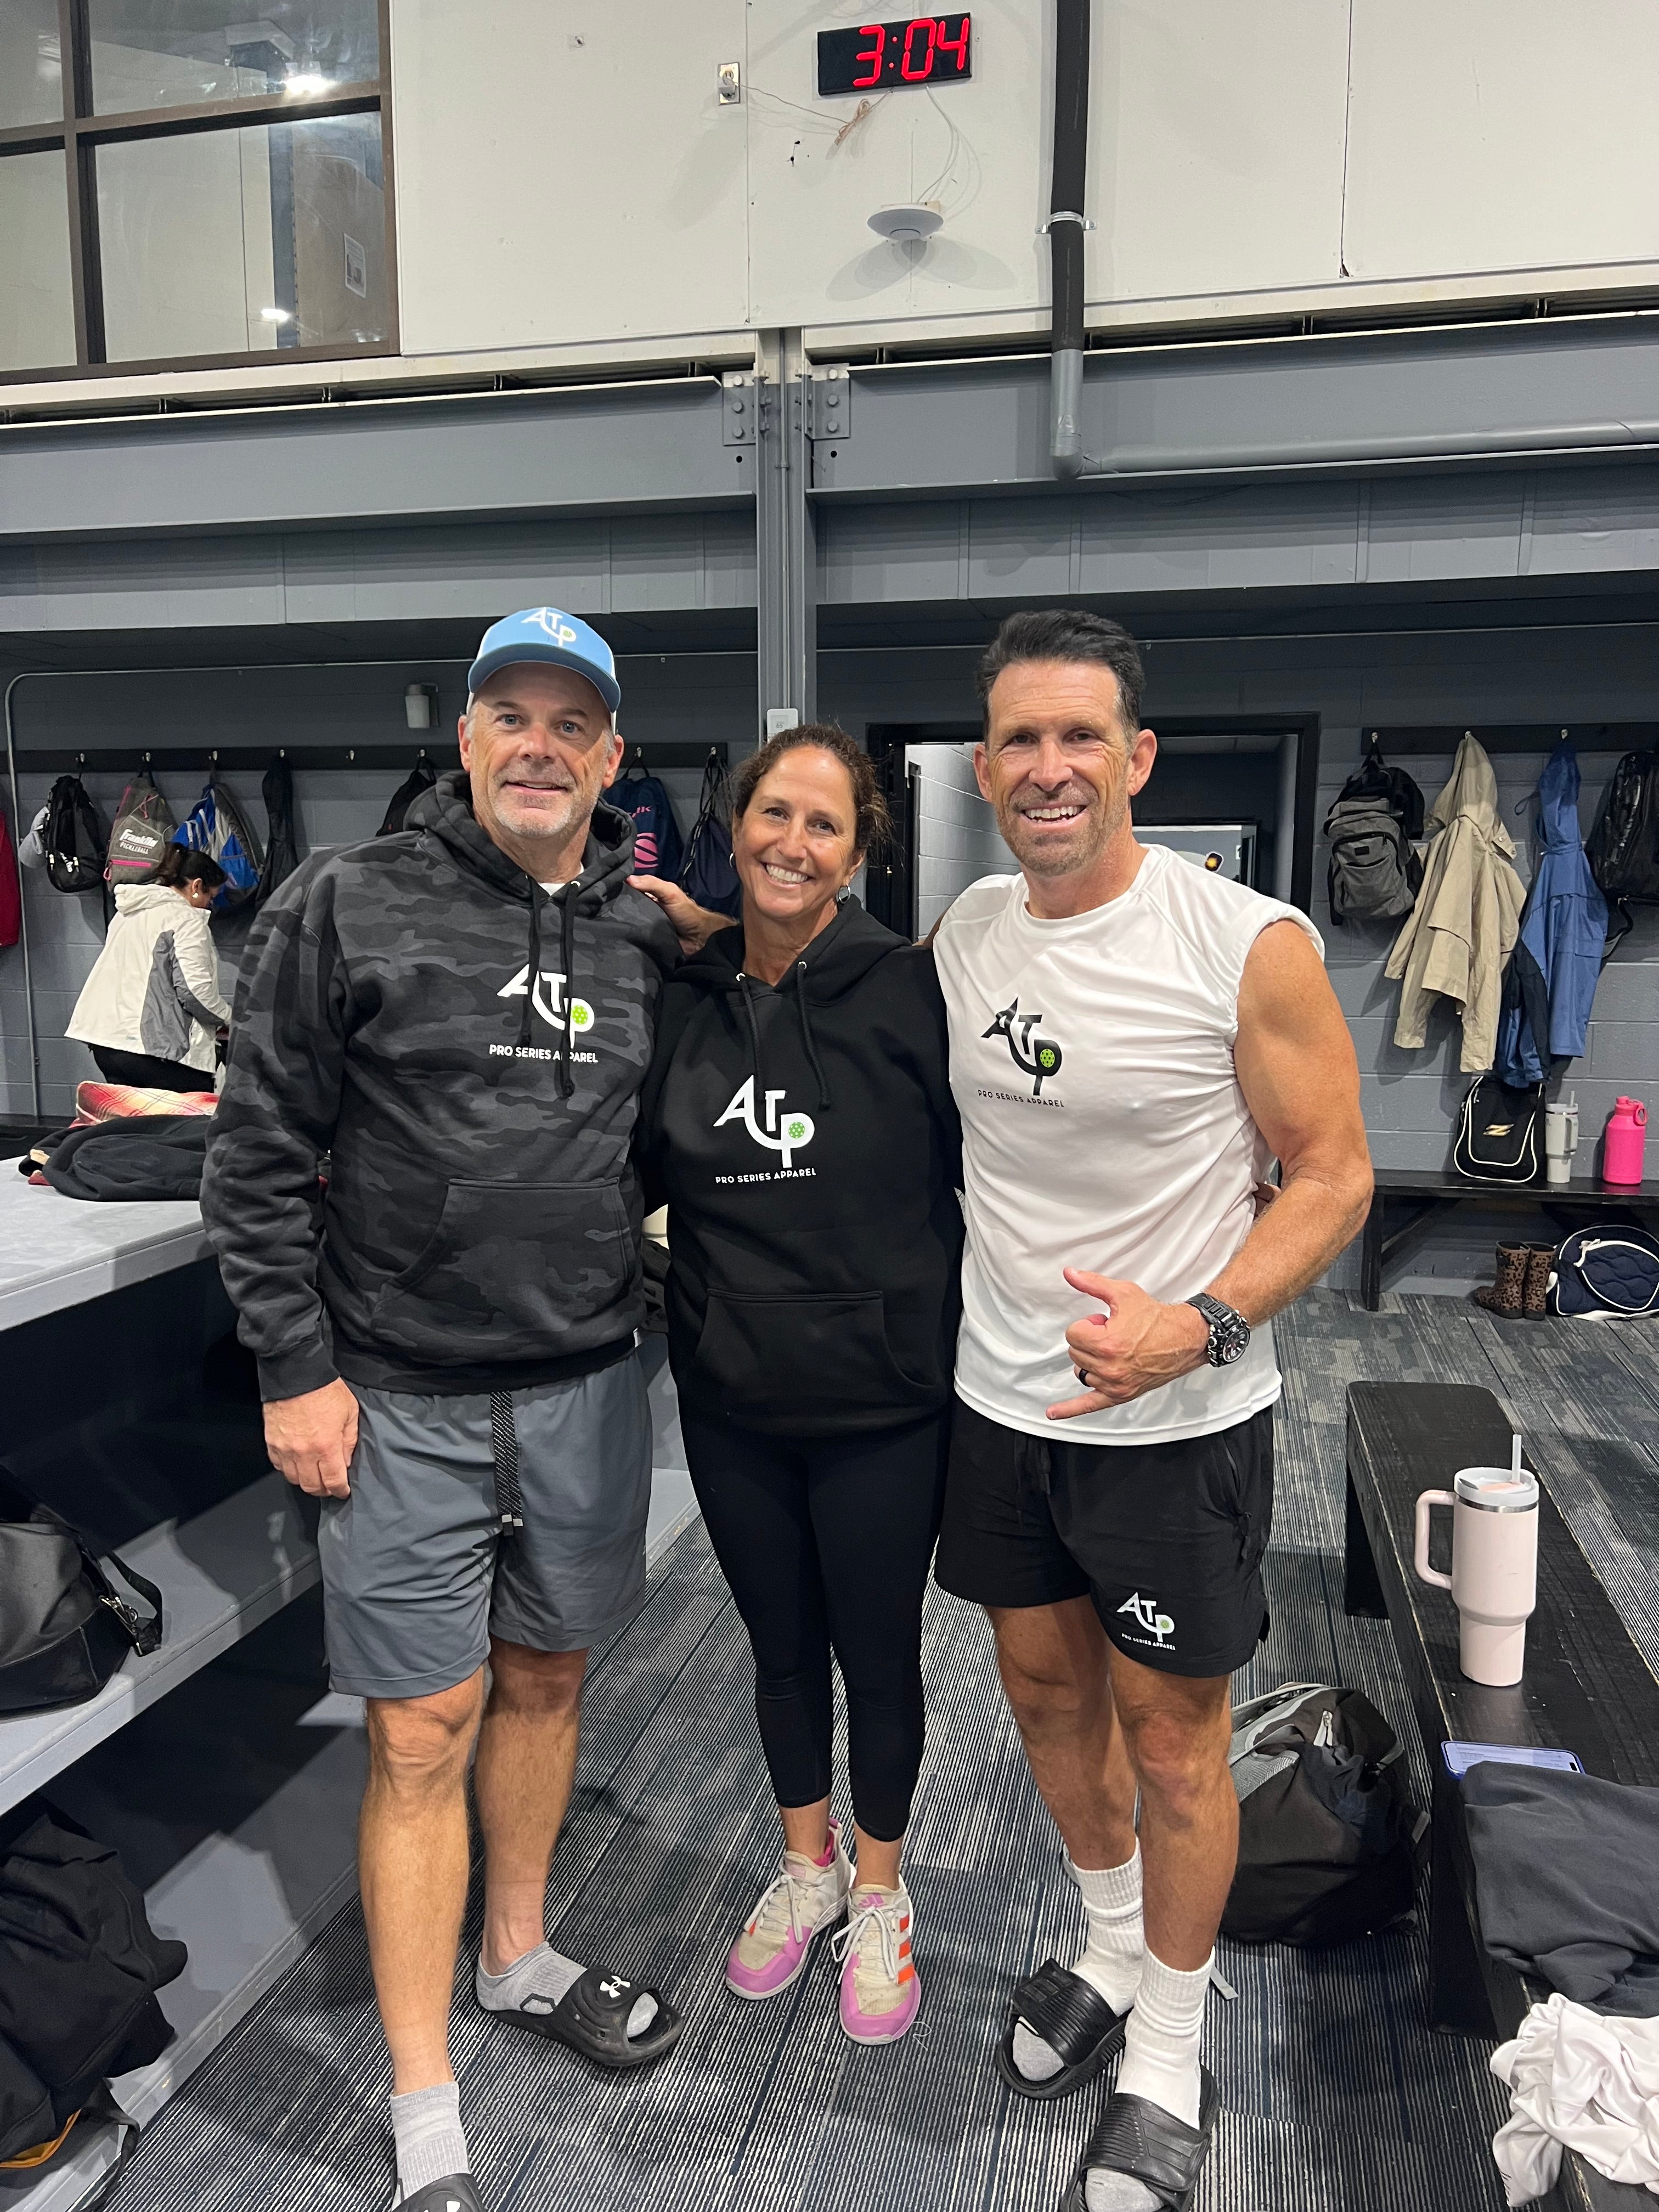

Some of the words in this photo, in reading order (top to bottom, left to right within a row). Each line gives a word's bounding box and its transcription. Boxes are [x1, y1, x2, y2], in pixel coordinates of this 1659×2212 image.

[853, 18, 969, 87] 3:04
[489, 1044, 513, 1057] PRO
[515, 1047, 551, 1060] SERIES
[552, 1050, 599, 1063] APAREL
[978, 1090, 993, 1098] PRO
[996, 1092, 1024, 1102] SERIES
[1027, 1098, 1064, 1107] APPAREL
[715, 1176, 735, 1184] PRO
[737, 1172, 771, 1183] SERIES
[774, 1167, 816, 1180] APPAREL
